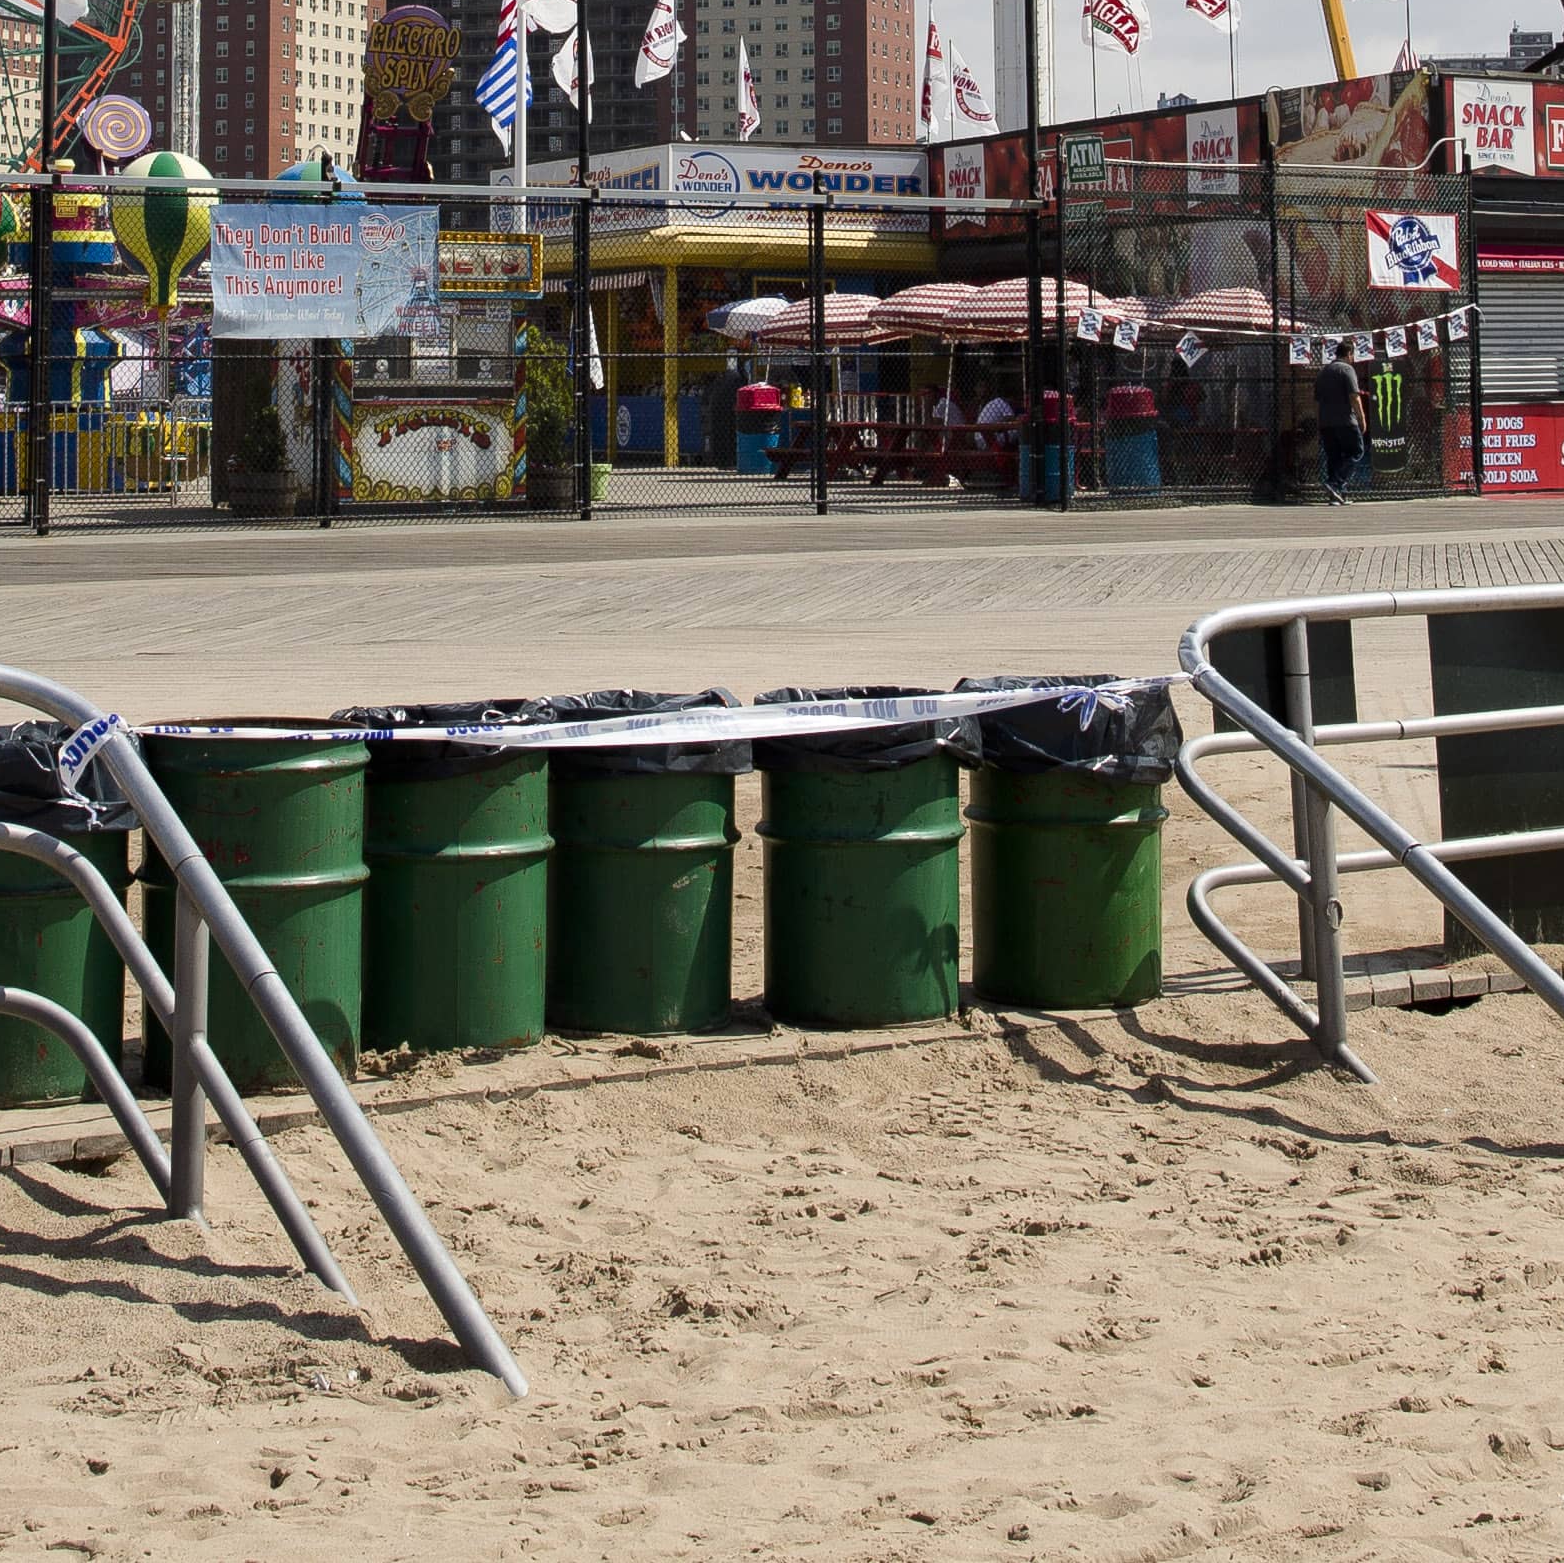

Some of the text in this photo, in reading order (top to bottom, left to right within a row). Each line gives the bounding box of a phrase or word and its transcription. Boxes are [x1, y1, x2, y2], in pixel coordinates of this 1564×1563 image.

[367, 22, 462, 59] ELECTRO
[381, 56, 432, 91] SPIN
[1476, 81, 1512, 103] Deno's
[1462, 103, 1527, 128] SNACK
[1192, 136, 1234, 161] SNACK
[1476, 126, 1515, 150] BAR
[797, 155, 874, 172] Deno's
[1070, 142, 1103, 167] ATM
[1477, 151, 1496, 161] SINCE
[568, 164, 612, 185] Dno's
[677, 157, 729, 181] Deno's
[948, 165, 983, 187] SNACK
[1073, 165, 1101, 174] MACHINE
[682, 181, 733, 194] WONDER
[747, 169, 925, 196] WONDER
[215, 223, 353, 250] They Don't Build
[1395, 224, 1422, 247] Pabst
[243, 249, 326, 270] Them Like
[225, 274, 344, 301] This Anymore!
[265, 309, 298, 323] Wonder
[298, 309, 323, 322] Wheel
[323, 309, 345, 324] Today
[374, 409, 493, 449] TICKETS
[1497, 417, 1524, 430] DOGS
[1371, 436, 1406, 449] MONSTER
[1505, 434, 1536, 448] FRIES
[1483, 452, 1522, 466] HICKEN
[1481, 469, 1539, 484] COLD SODA
